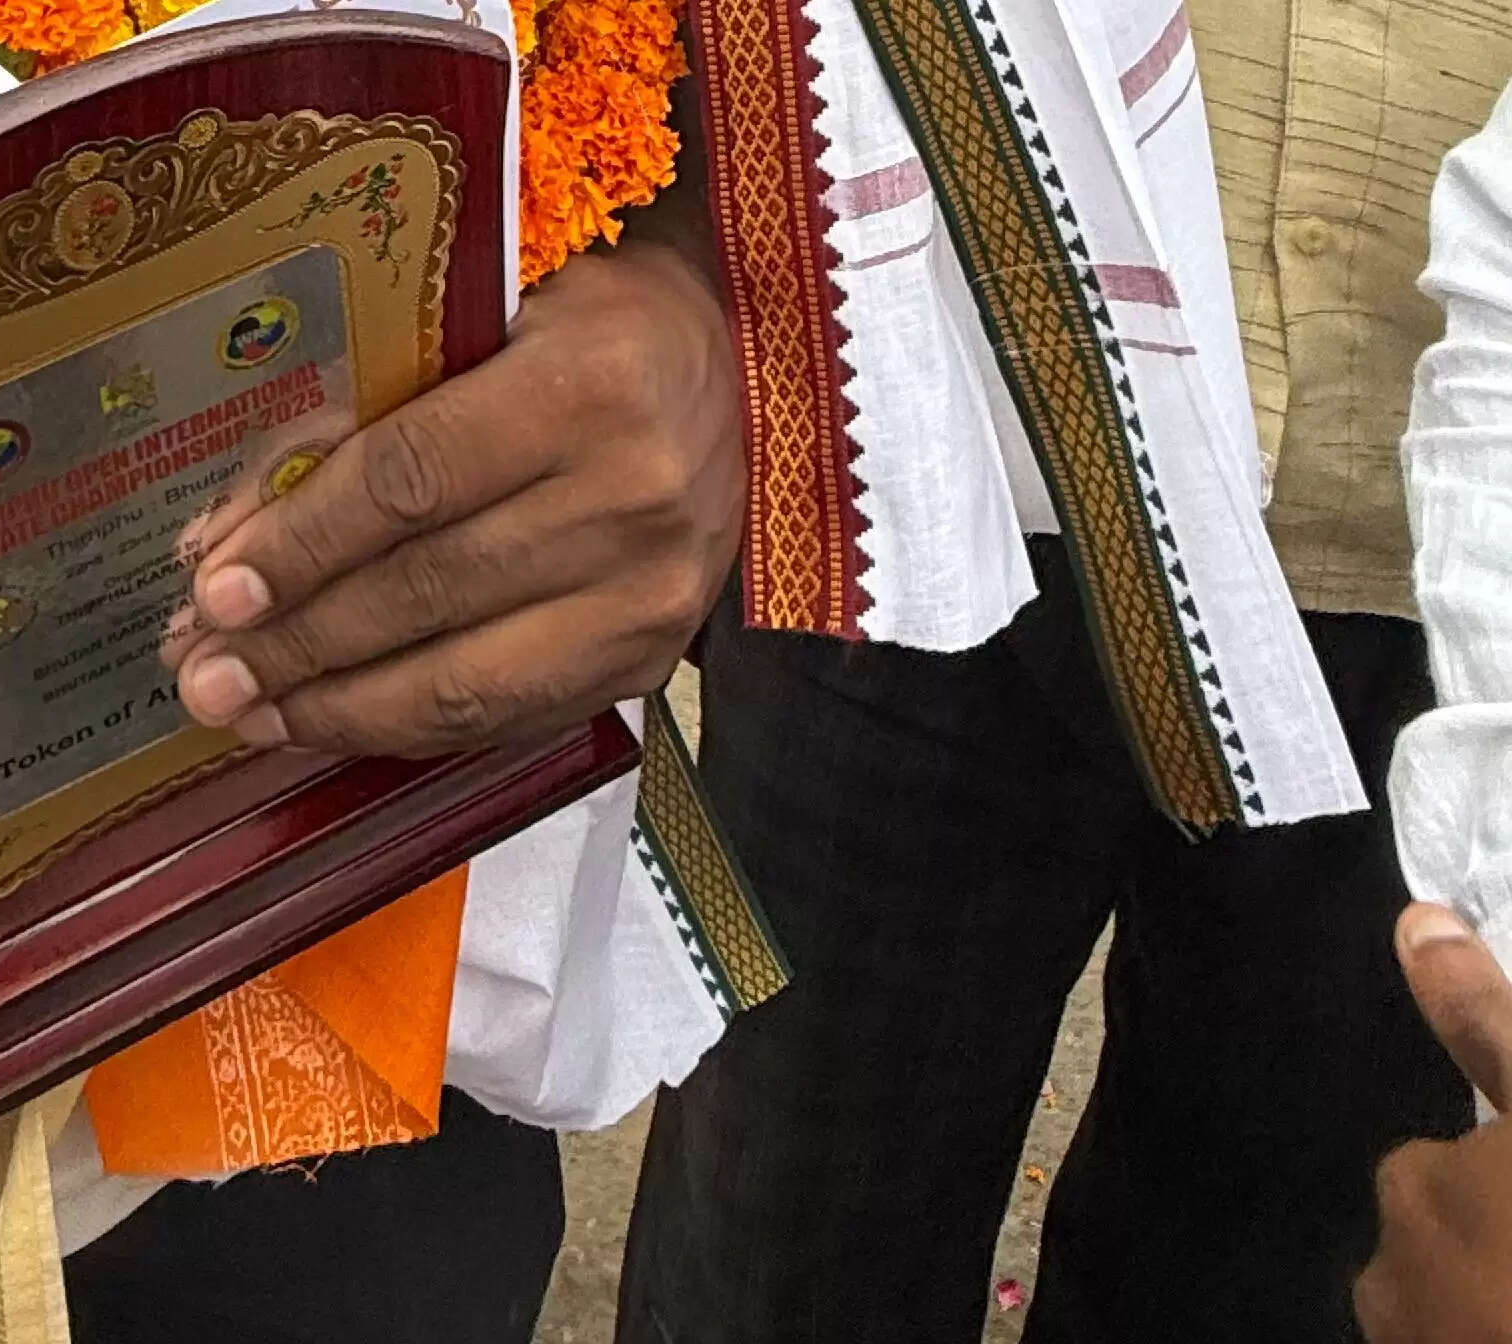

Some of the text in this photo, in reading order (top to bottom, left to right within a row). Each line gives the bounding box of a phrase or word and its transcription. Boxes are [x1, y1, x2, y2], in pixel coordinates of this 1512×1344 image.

[65, 445, 131, 492] OPEN
[135, 360, 322, 462] INTERNATIONAL
[42, 506, 145, 562] Thimphu
[165, 459, 246, 507] Bhutan
[136, 548, 203, 587] KARATE
[33, 641, 104, 681] BHUTAN
[42, 661, 112, 704] BHUTAN
[104, 699, 136, 729] of
